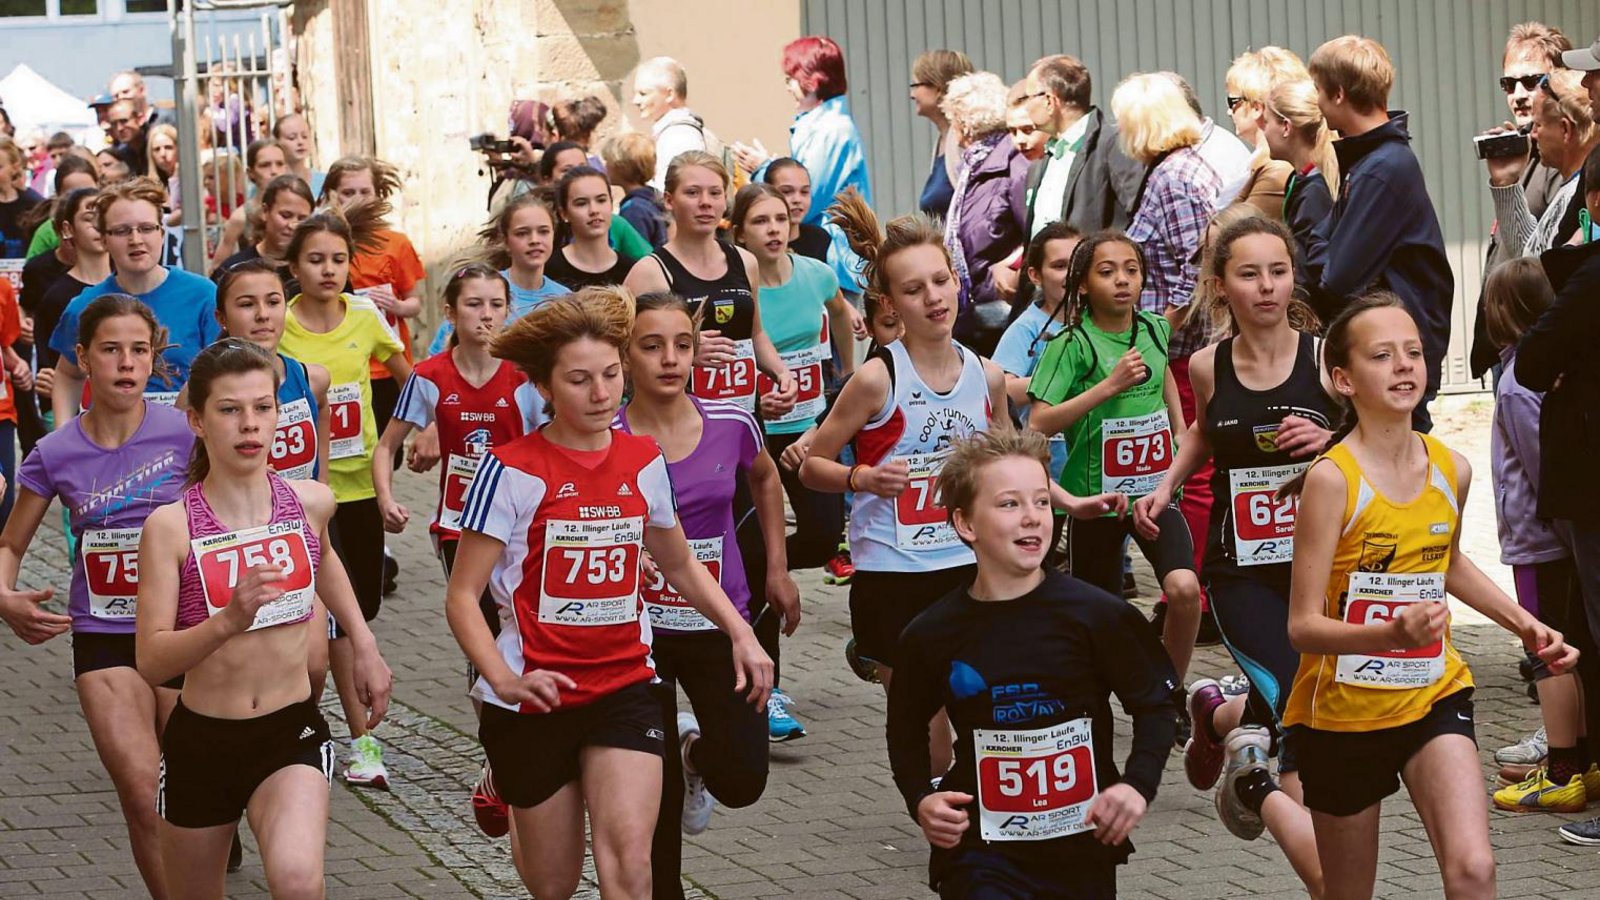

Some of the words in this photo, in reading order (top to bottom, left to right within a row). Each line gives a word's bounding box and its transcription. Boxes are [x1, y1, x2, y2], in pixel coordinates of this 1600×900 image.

[703, 361, 748, 390] 712
[1116, 434, 1165, 466] 673
[1245, 471, 1260, 479] 12.
[1262, 468, 1291, 478] Illinger
[1249, 493, 1299, 526] 62
[267, 520, 302, 535] EnBW
[564, 525, 579, 533] 12.
[582, 525, 610, 534] Illinger
[96, 532, 109, 540] 12.
[614, 532, 641, 543] EnBW
[98, 552, 139, 584] 75
[216, 539, 295, 588] 758
[563, 547, 627, 585] 753
[1368, 576, 1385, 586] 12.
[1387, 577, 1415, 588] Illinger
[1419, 589, 1444, 599] EnBW
[600, 599, 626, 608] SPORT
[1402, 660, 1431, 669] SPORT
[993, 734, 1010, 743] 12.
[1013, 733, 1048, 744] Illinger
[1050, 725, 1075, 738] Läufe
[1056, 731, 1090, 751] EnBW
[998, 753, 1077, 797] 519
[1032, 798, 1048, 807] Lea
[1031, 814, 1046, 822] AR
[1048, 805, 1081, 820] SPORT
